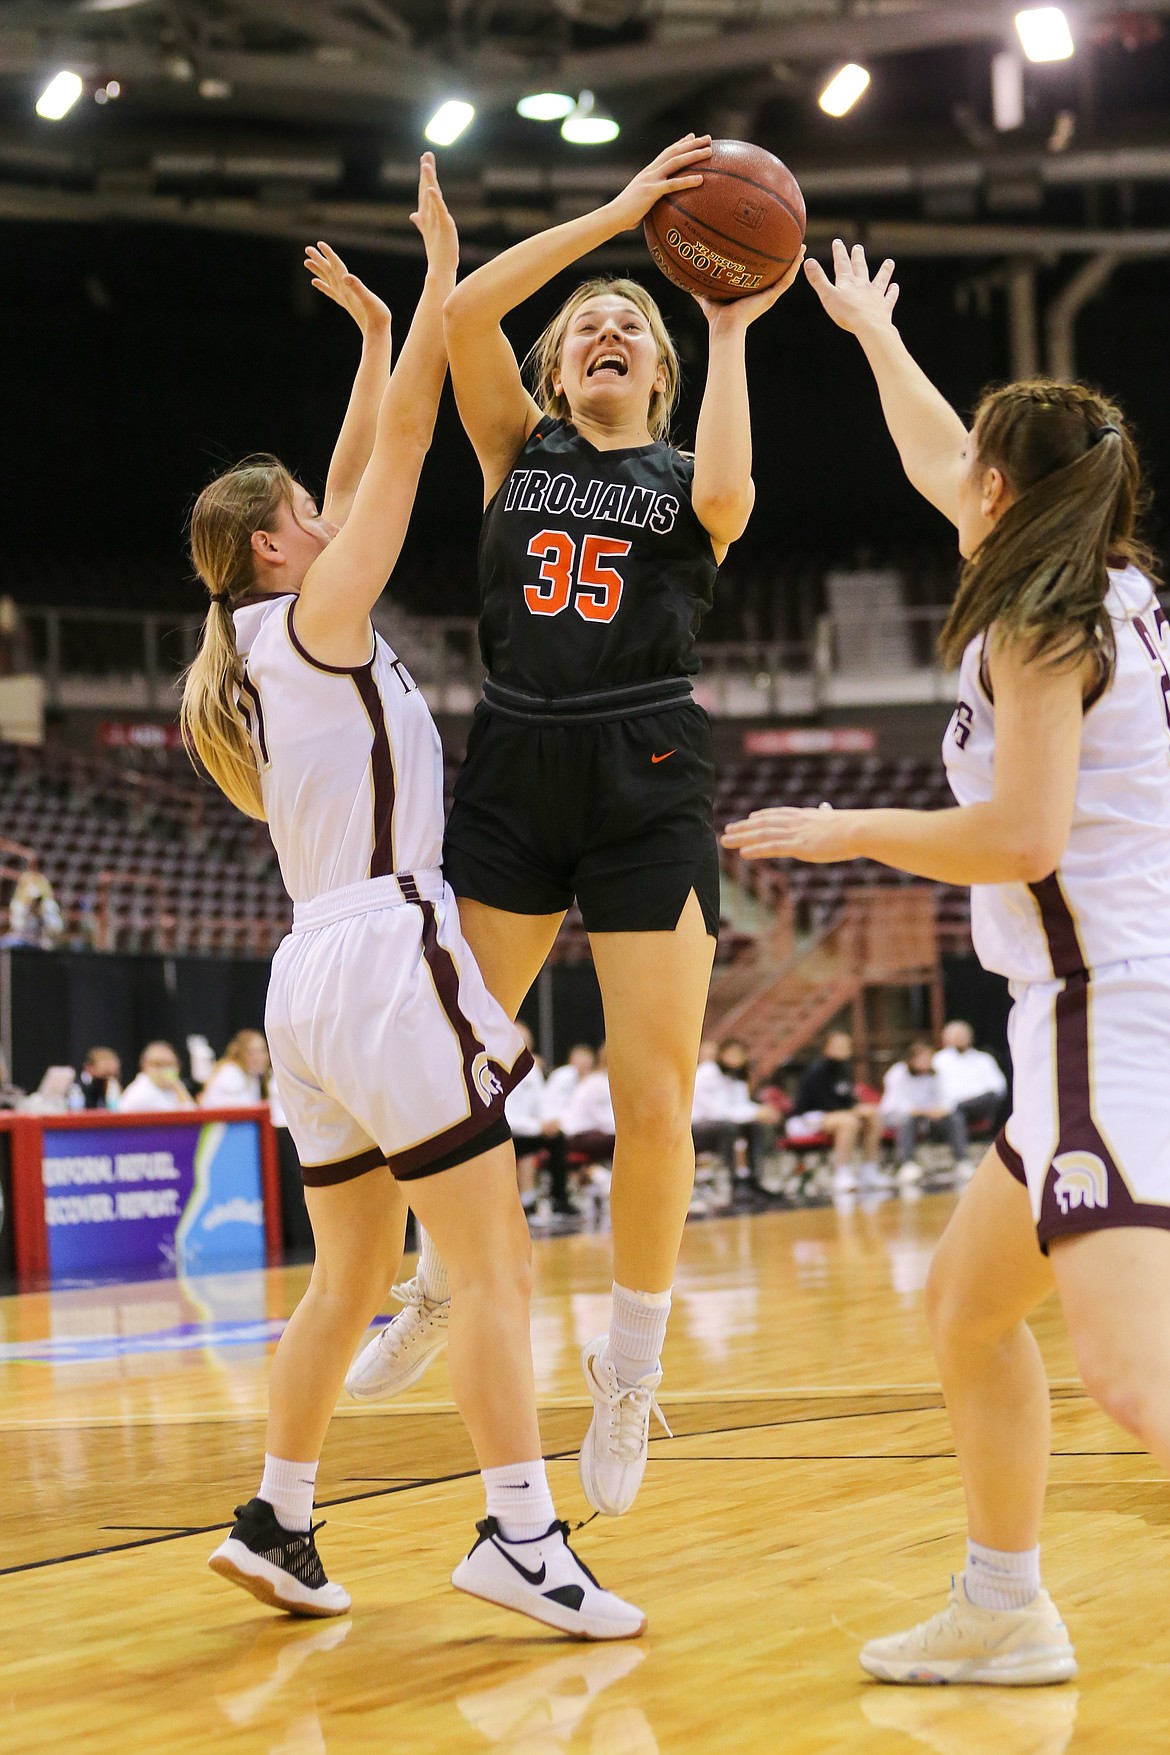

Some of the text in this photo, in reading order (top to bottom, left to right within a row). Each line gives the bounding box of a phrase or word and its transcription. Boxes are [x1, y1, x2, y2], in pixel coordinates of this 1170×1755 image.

[666, 228, 763, 289] TF-1000
[709, 251, 747, 273] CLASSIC
[504, 469, 680, 535] TROJANS
[523, 529, 632, 623] 35
